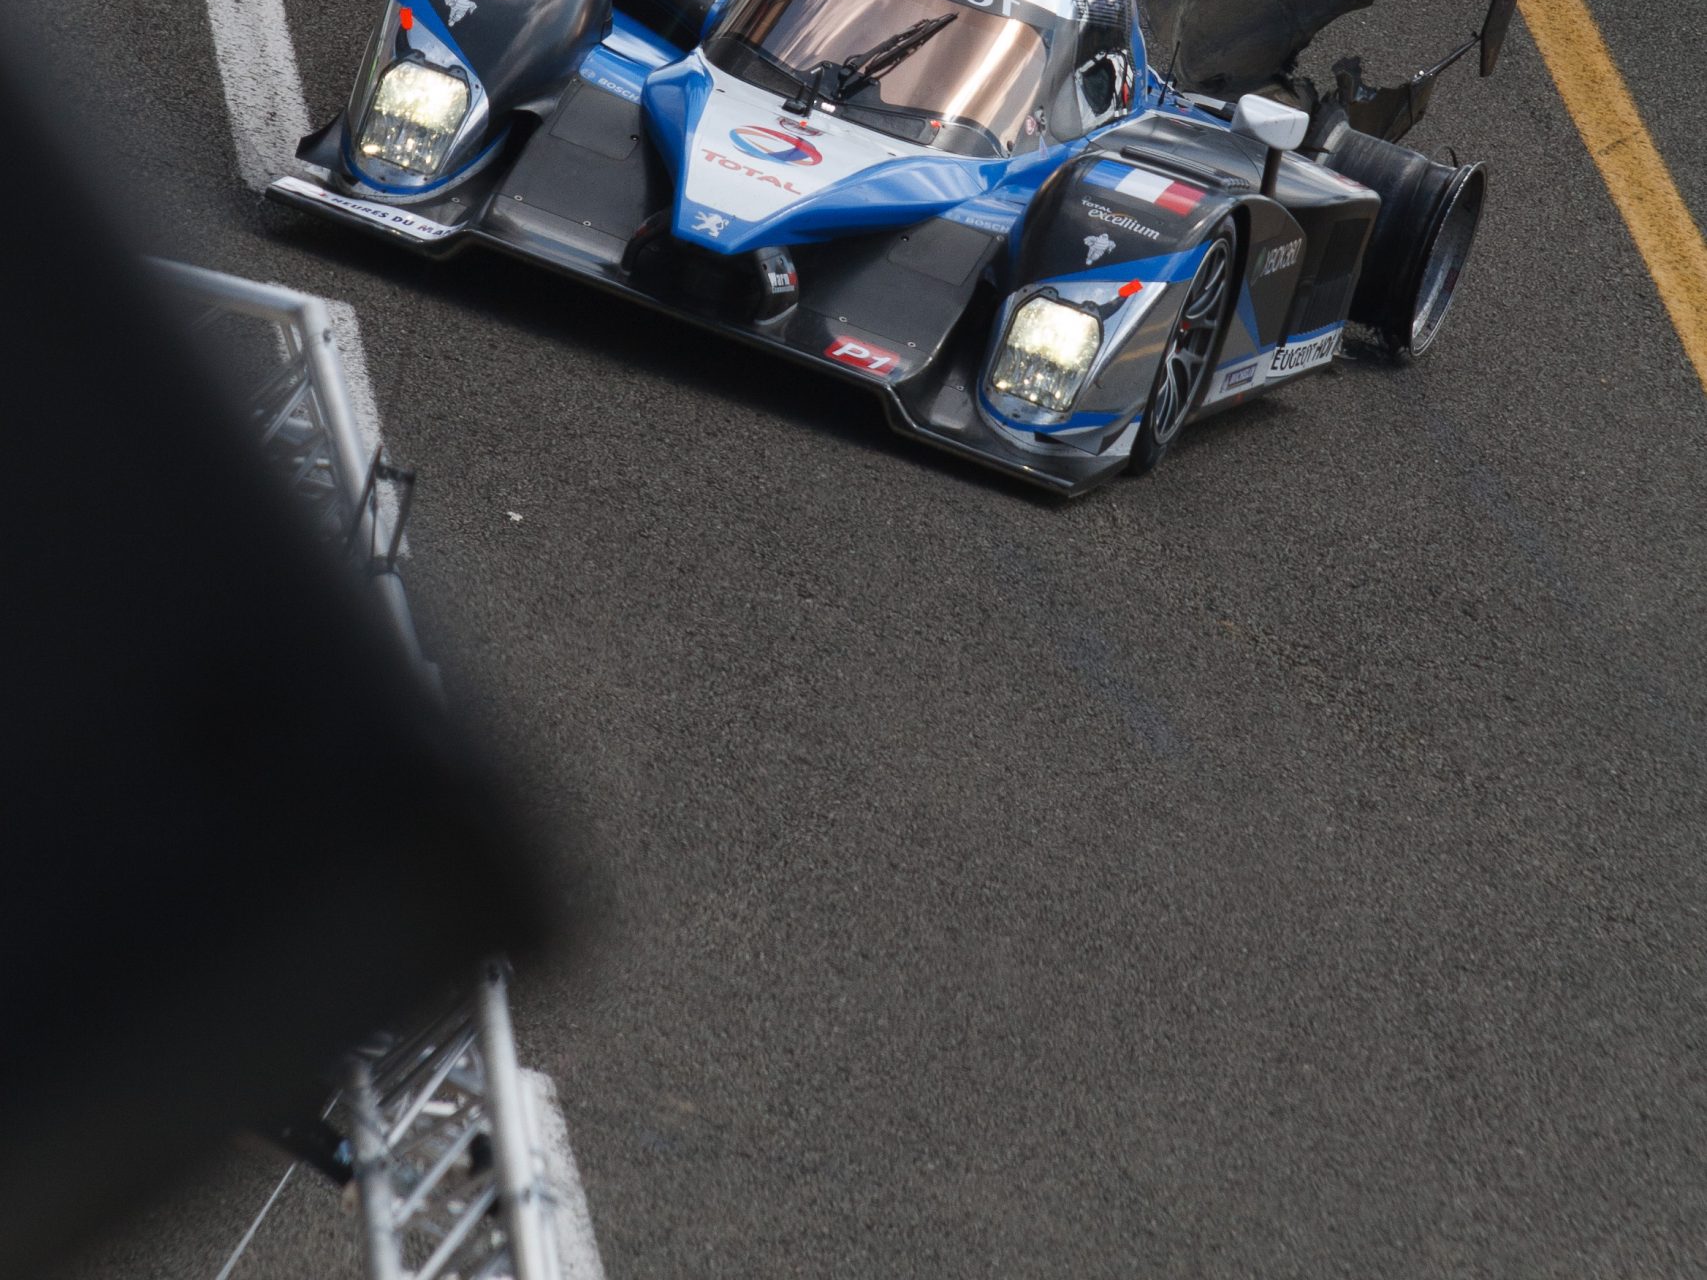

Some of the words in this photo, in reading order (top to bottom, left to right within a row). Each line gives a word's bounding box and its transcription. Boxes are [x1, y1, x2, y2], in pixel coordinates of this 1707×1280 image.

[598, 77, 640, 101] BOSCH
[701, 148, 802, 195] TOTAL
[331, 197, 390, 219] HEURES
[391, 214, 414, 227] DU
[1081, 199, 1112, 214] TOTAL
[1088, 208, 1160, 241] excellium
[832, 342, 892, 370] P1
[1270, 341, 1319, 371] EUGEOT
